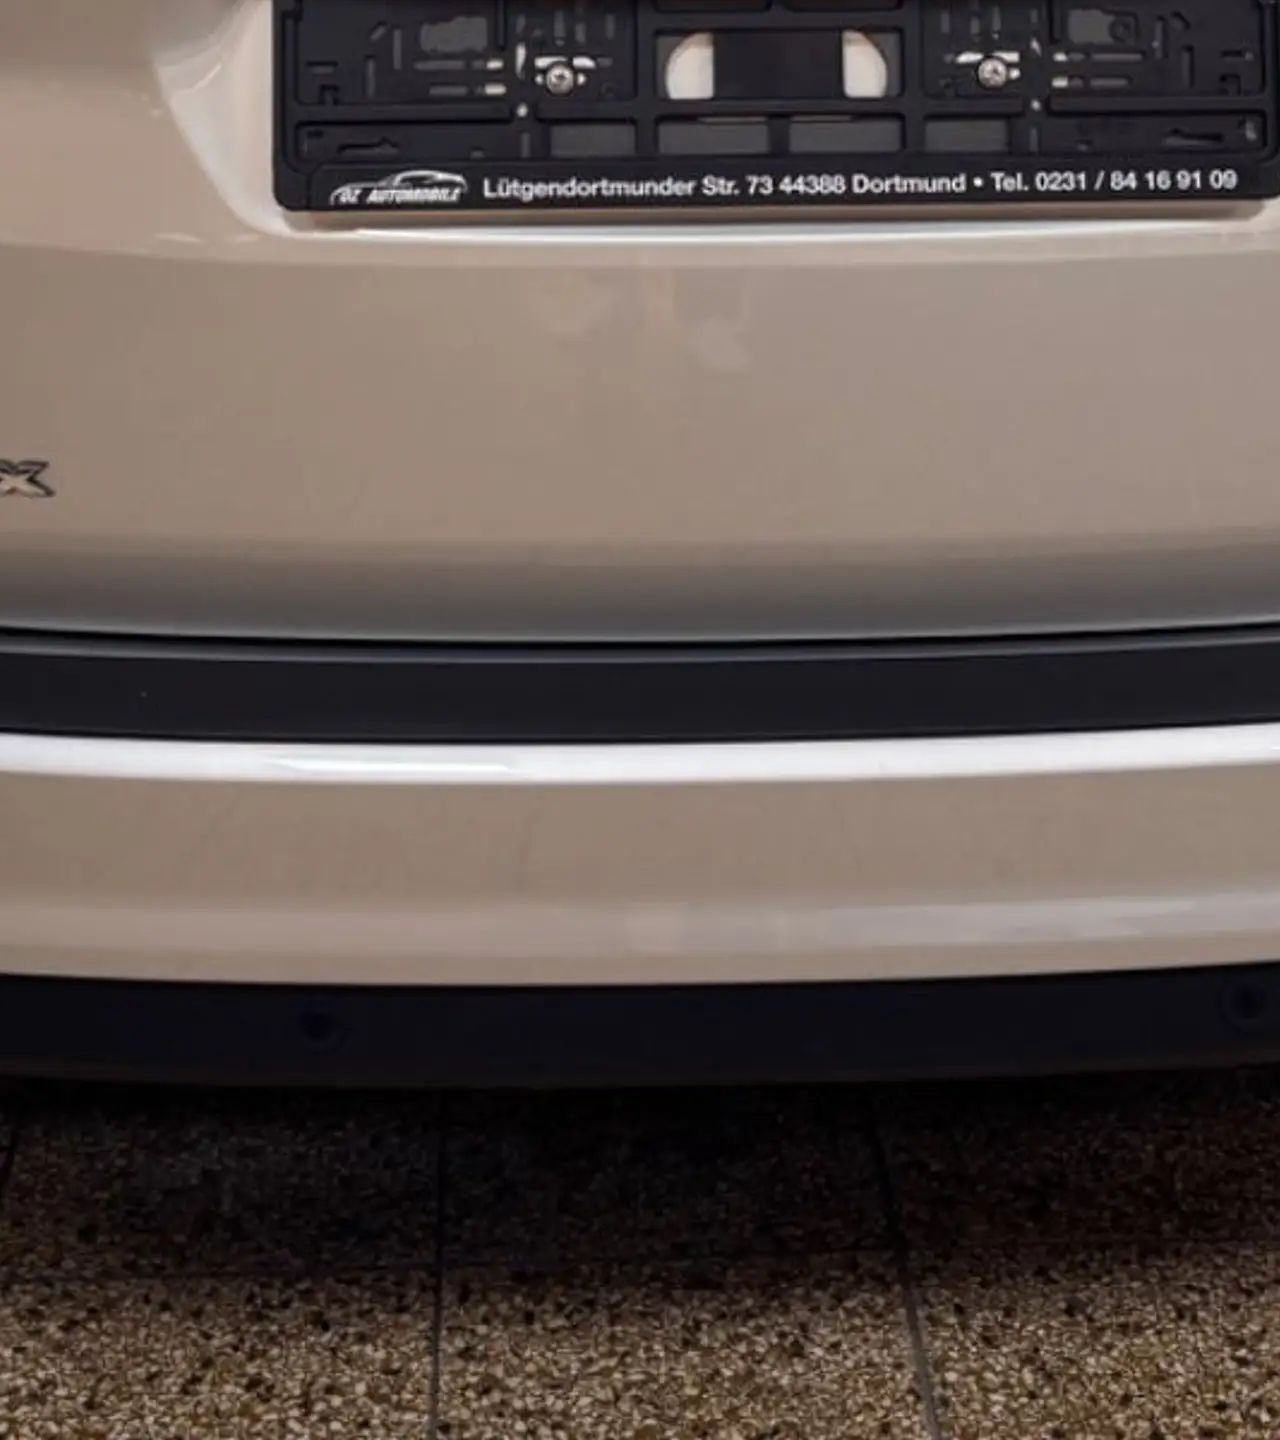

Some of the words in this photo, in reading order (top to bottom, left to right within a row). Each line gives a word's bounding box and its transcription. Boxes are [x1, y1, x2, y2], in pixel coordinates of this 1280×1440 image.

[483, 177, 696, 202] Lütgendortmunder
[702, 175, 740, 195] Str.
[746, 175, 774, 195] 73
[779, 174, 847, 194] 44388
[852, 173, 966, 193] Dortmund
[990, 172, 1029, 191] Tel.
[1035, 171, 1086, 191] 0231
[1110, 171, 1137, 190] 84
[1145, 170, 1171, 190] 16
[1176, 170, 1203, 190] 91
[1209, 170, 1239, 190] 09
